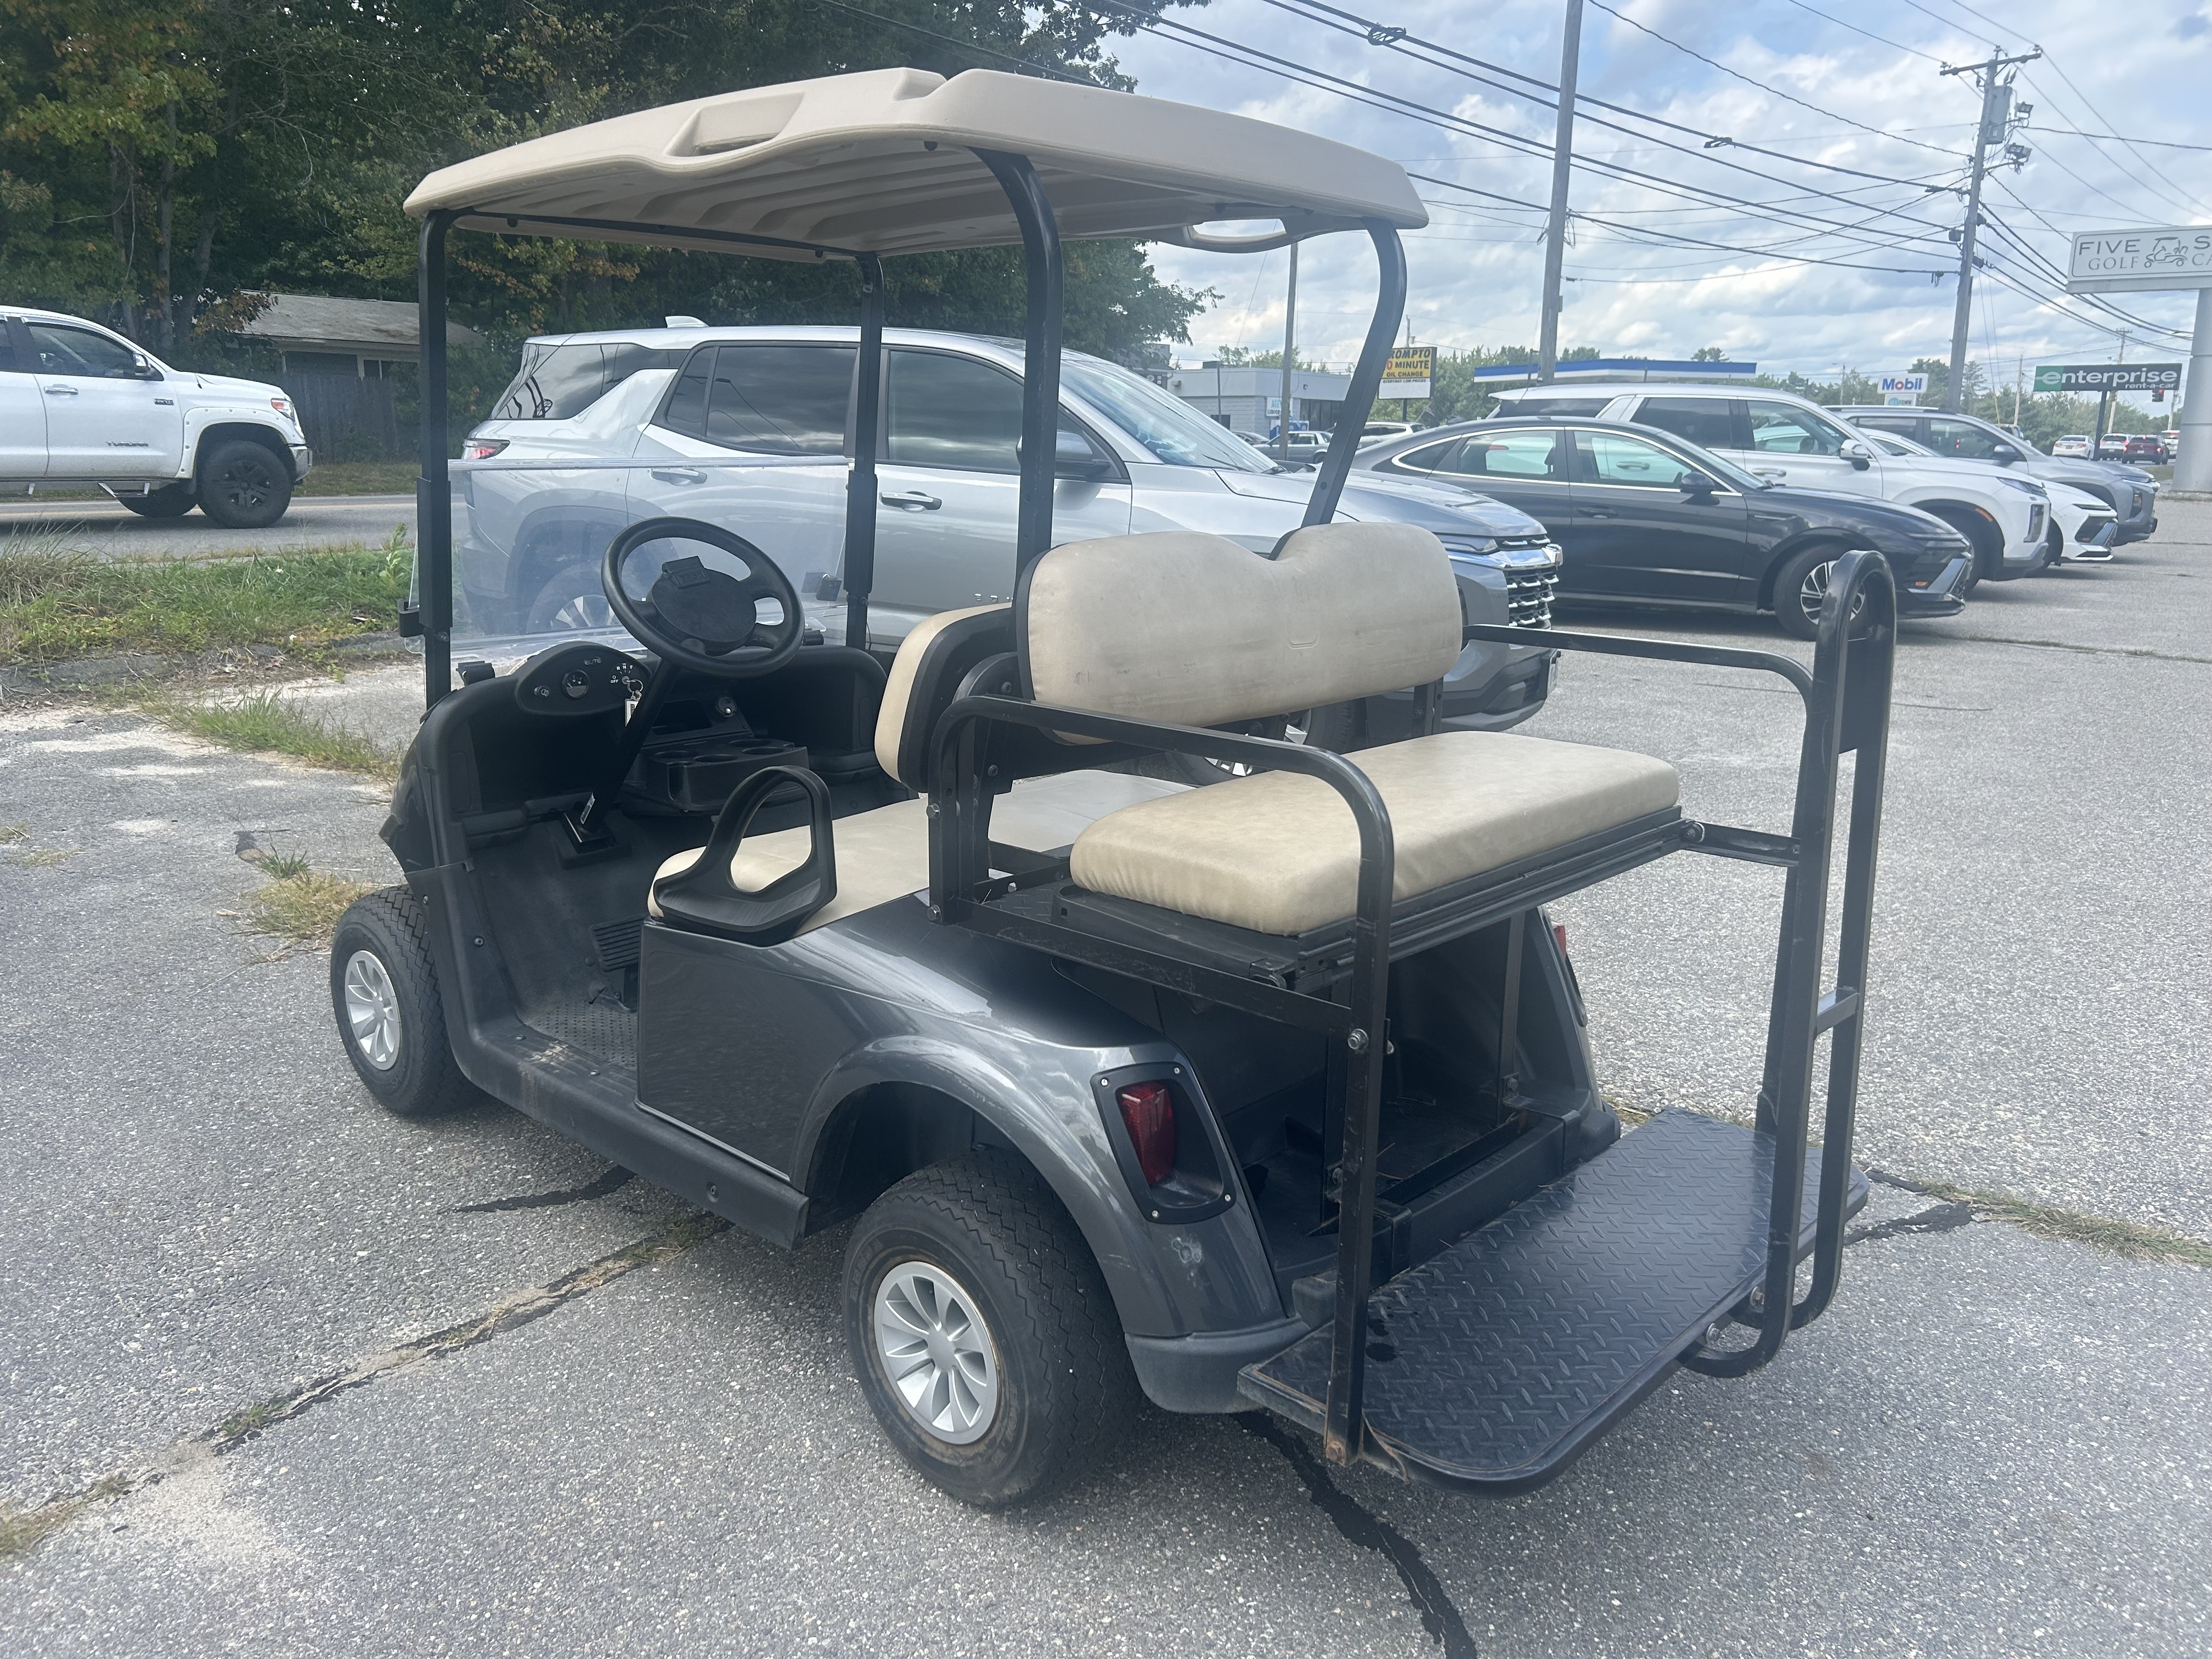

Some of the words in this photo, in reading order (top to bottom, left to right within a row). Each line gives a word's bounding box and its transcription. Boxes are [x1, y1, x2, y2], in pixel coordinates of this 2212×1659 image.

[2079, 239, 2141, 255] FIVE
[2088, 256, 2138, 270] GOLF
[1391, 349, 1431, 359] ROMPTO
[1386, 360, 1393, 370] 0
[1395, 360, 1429, 369] MINUTE
[1882, 377, 1922, 390] Mobil
[2035, 367, 2177, 387] enterprise
